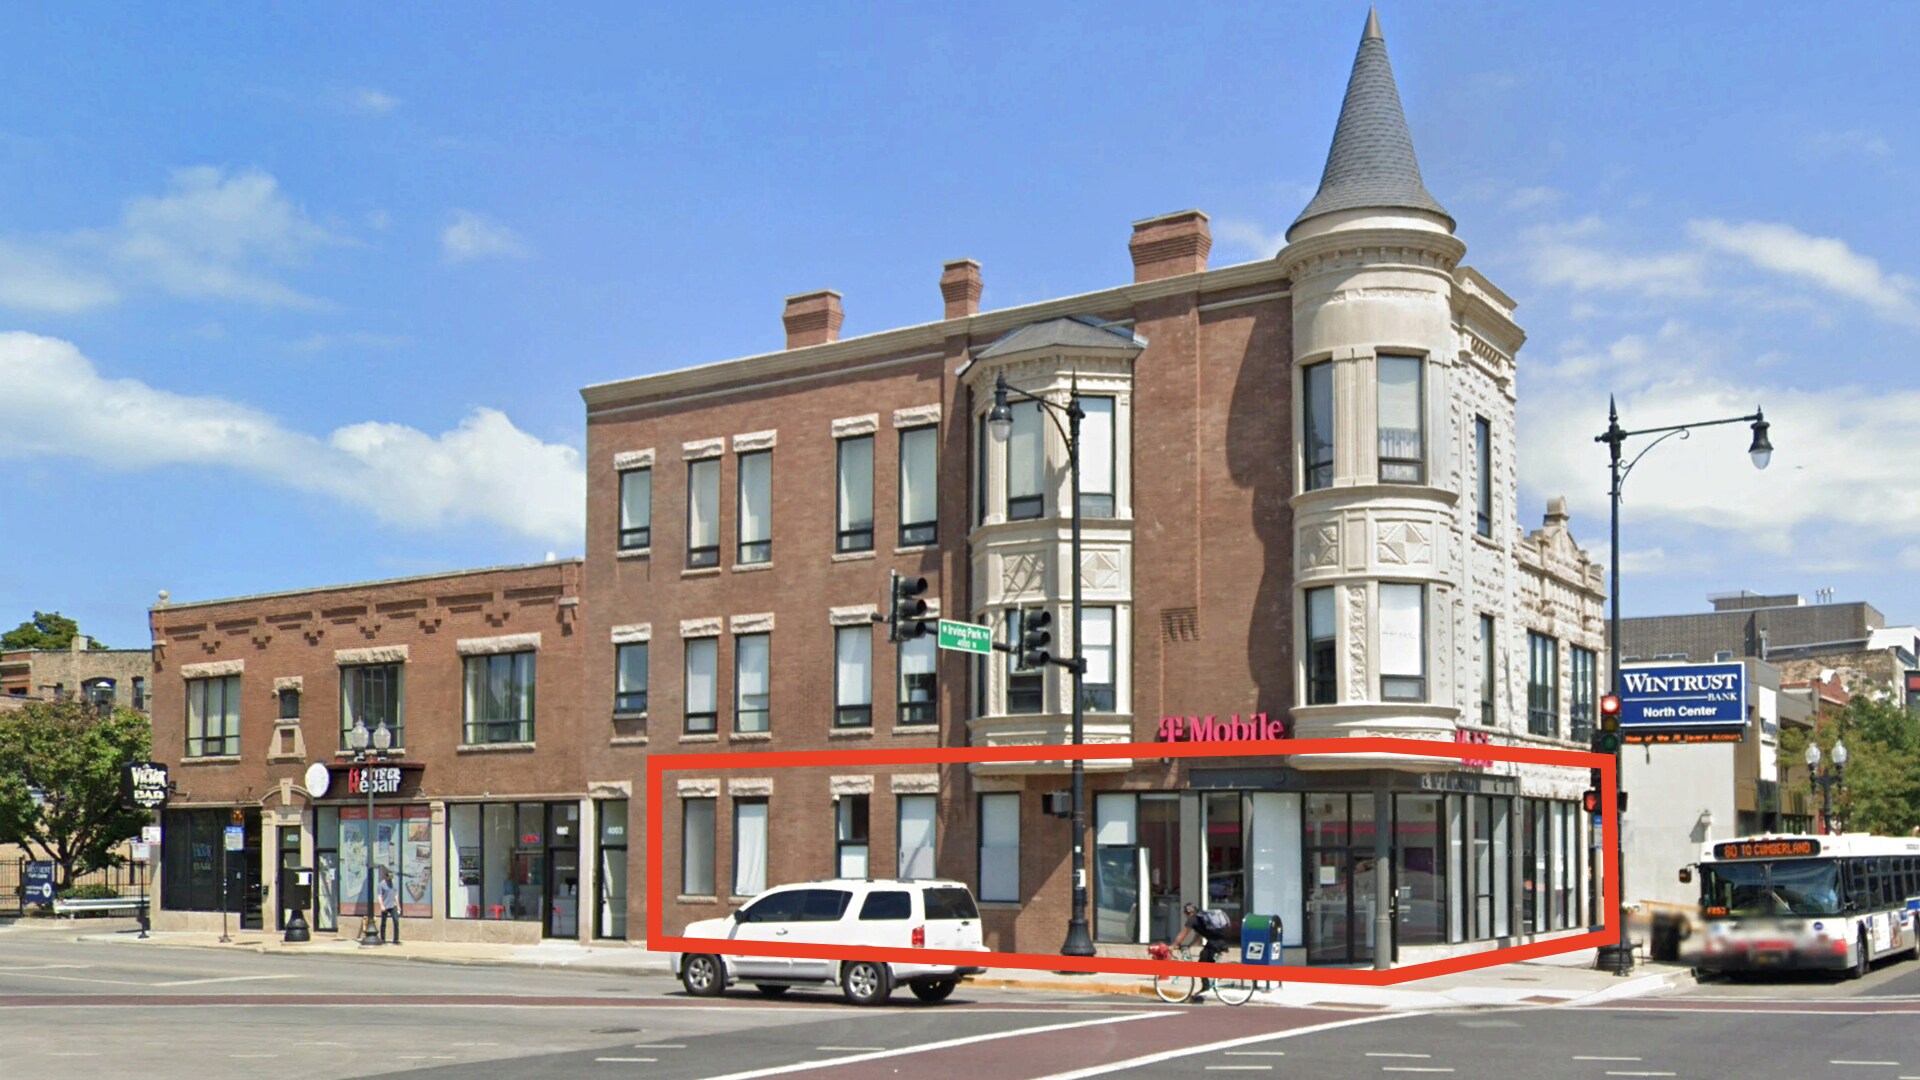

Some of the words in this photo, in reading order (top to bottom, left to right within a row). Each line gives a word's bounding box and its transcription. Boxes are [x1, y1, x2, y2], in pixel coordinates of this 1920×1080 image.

[948, 625, 966, 640] Irving
[967, 628, 982, 640] Park
[1707, 692, 1737, 701] BANK
[1643, 707, 1675, 717] North
[1678, 706, 1717, 717] Center
[1188, 712, 1286, 742] Mobile
[1657, 734, 1669, 742] the
[134, 789, 165, 799] BAR
[1724, 844, 1738, 859] 80
[1741, 844, 1752, 856] TO
[1753, 842, 1811, 855] CUMBERLAND
